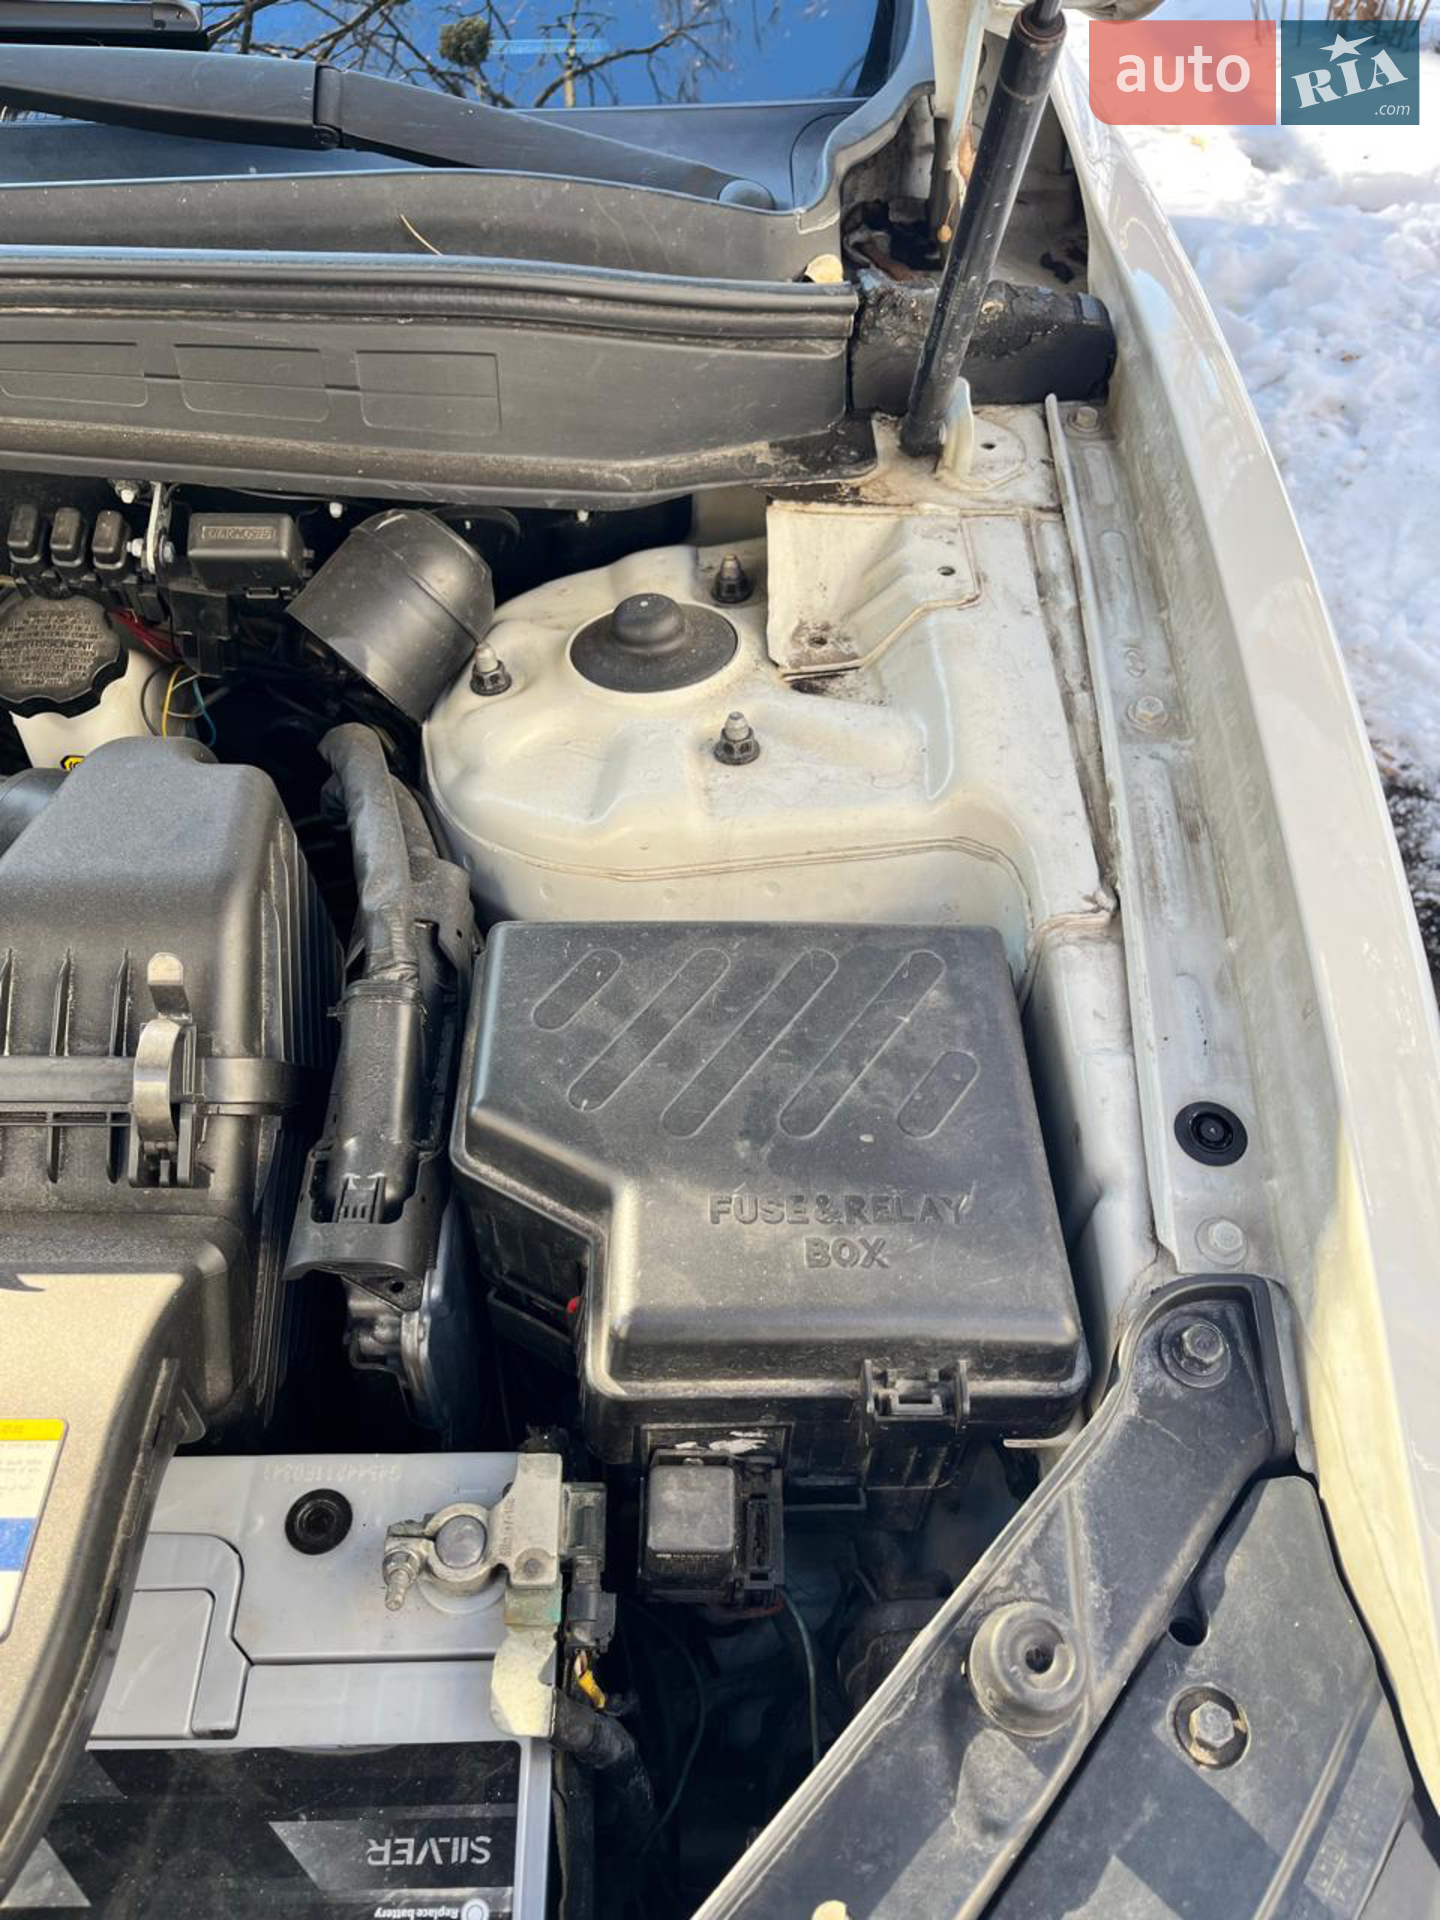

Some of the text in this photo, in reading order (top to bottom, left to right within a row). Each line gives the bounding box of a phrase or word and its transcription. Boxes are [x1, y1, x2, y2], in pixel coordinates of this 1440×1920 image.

[708, 1194, 969, 1224] FUSE&RELAY
[804, 1237, 890, 1269] BOX
[366, 1835, 492, 1866] SILVER
[374, 1906, 459, 1920] Replace battery
